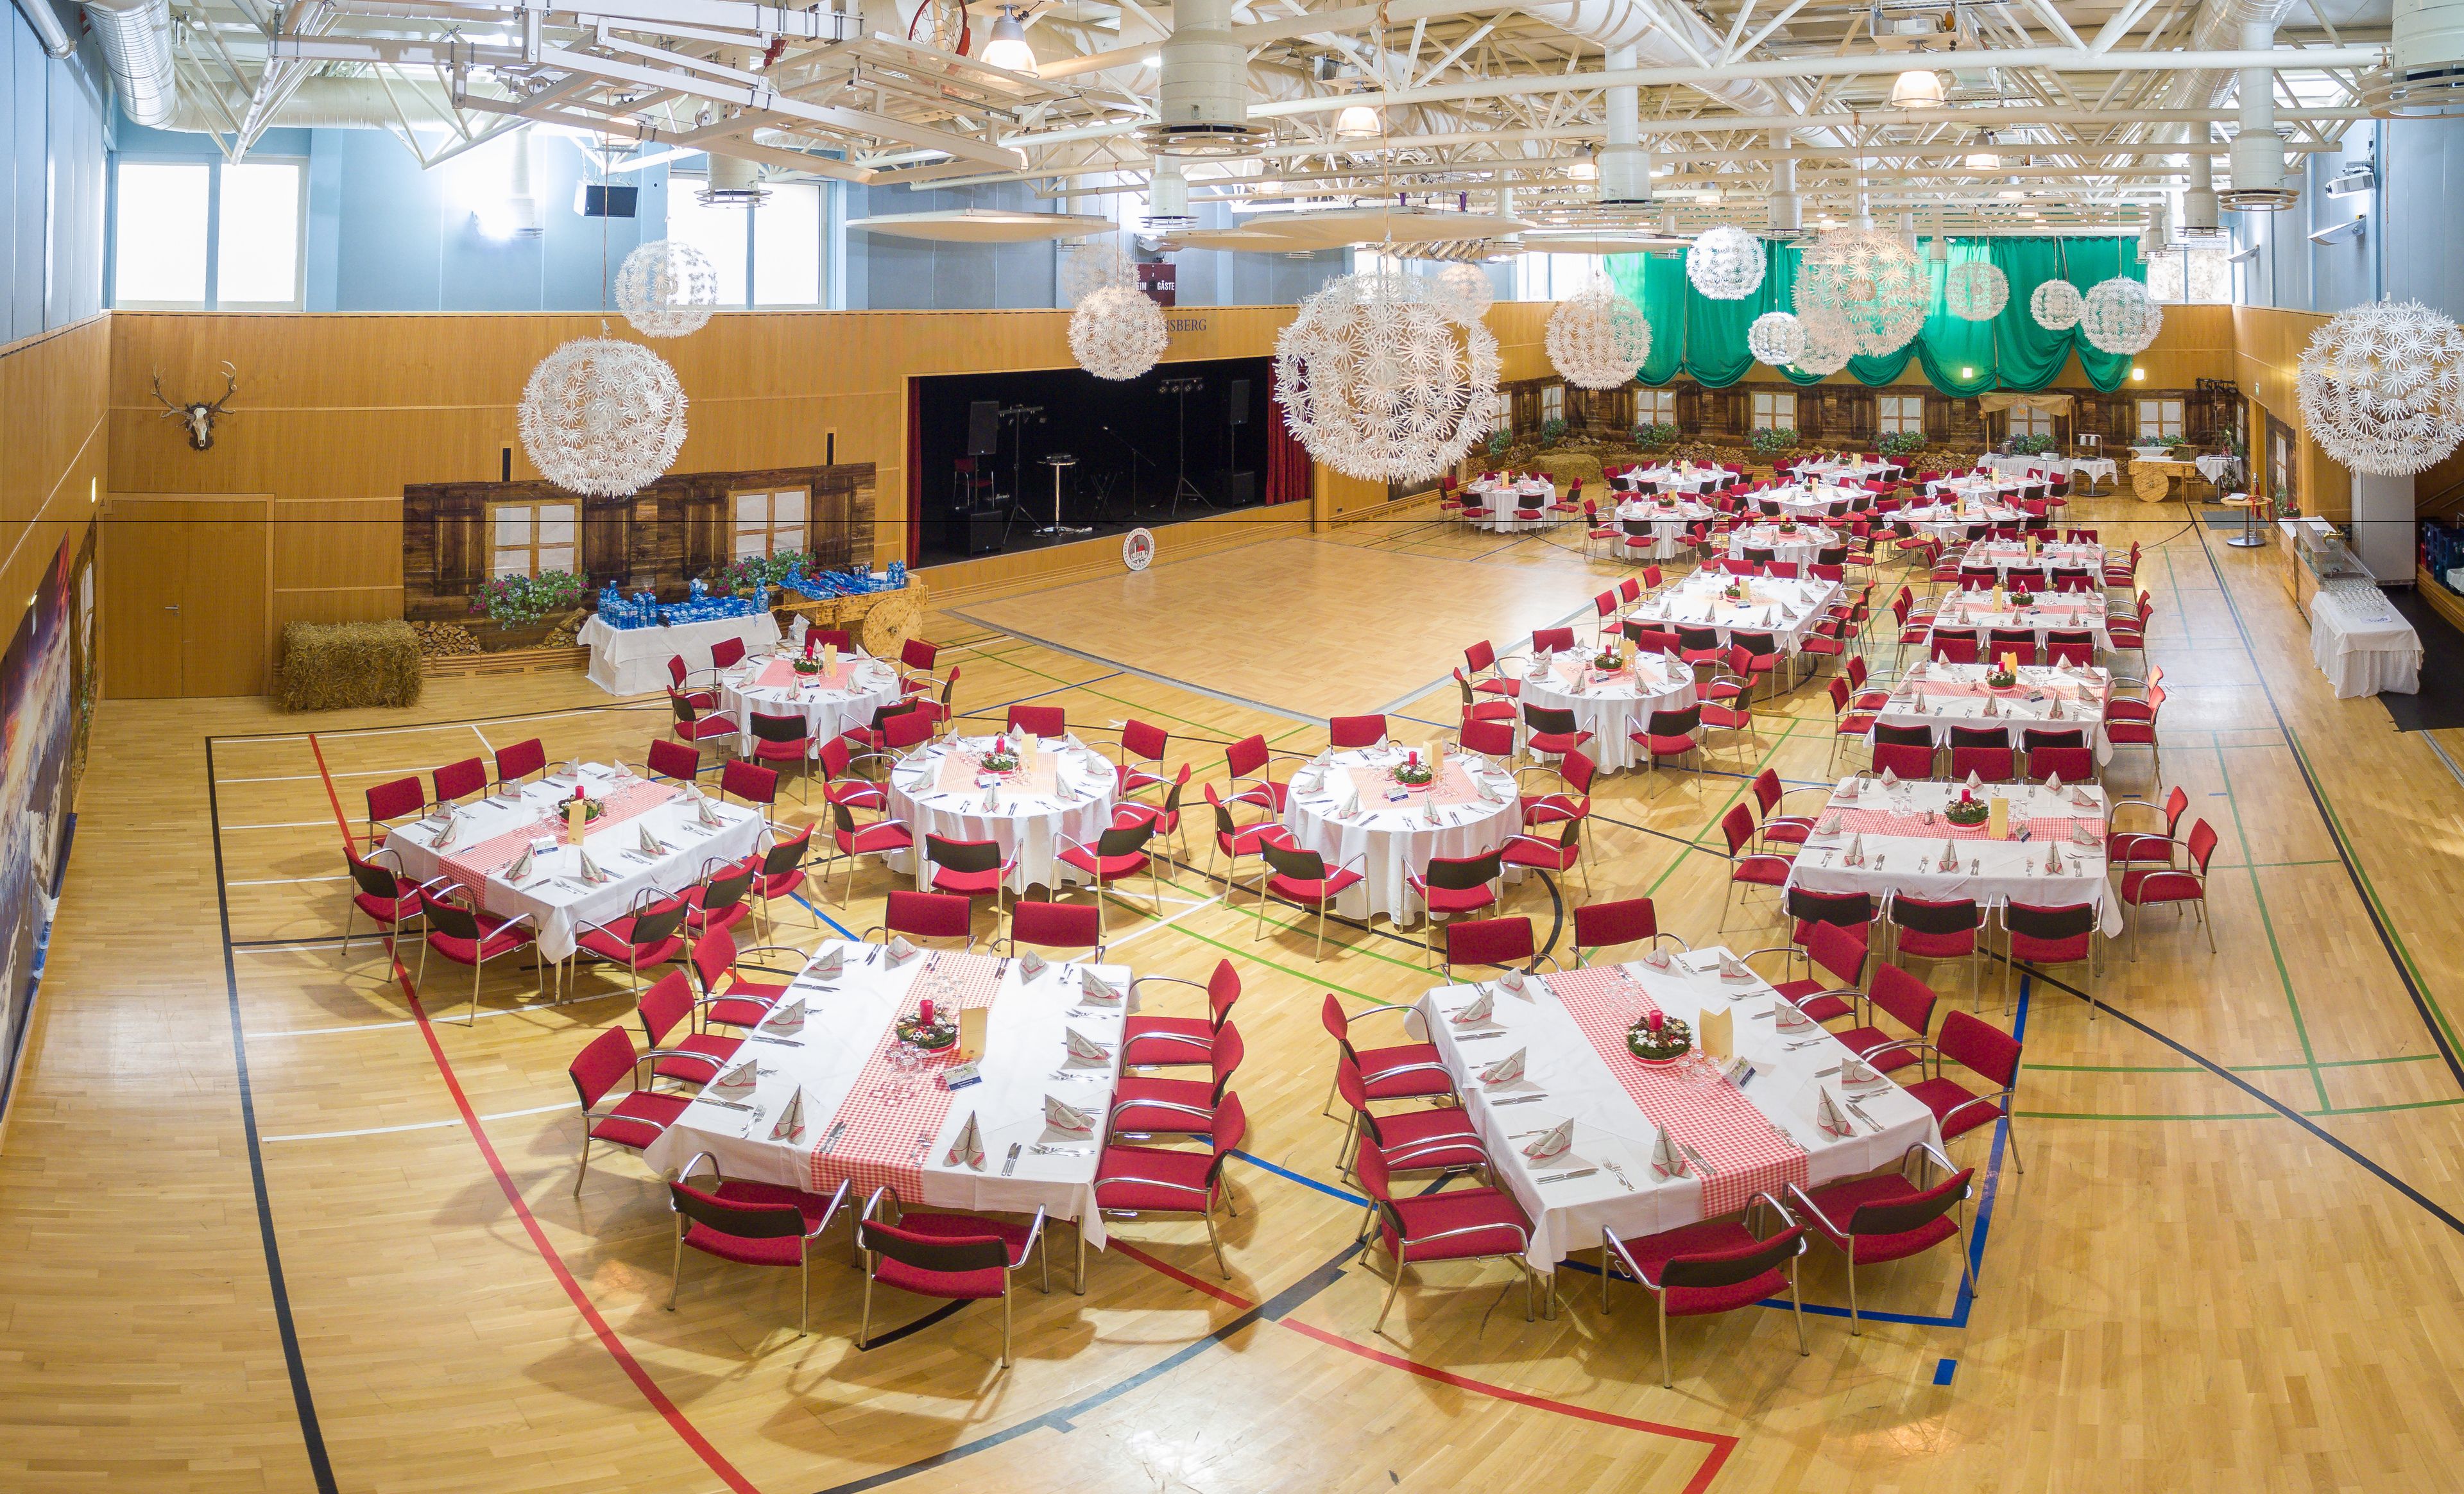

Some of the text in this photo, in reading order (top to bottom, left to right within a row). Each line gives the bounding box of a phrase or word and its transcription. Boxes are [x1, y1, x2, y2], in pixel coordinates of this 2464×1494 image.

[1136, 282, 1147, 291] EIM
[1157, 280, 1175, 291] GÄSTE
[1166, 319, 1207, 332] SBERG
